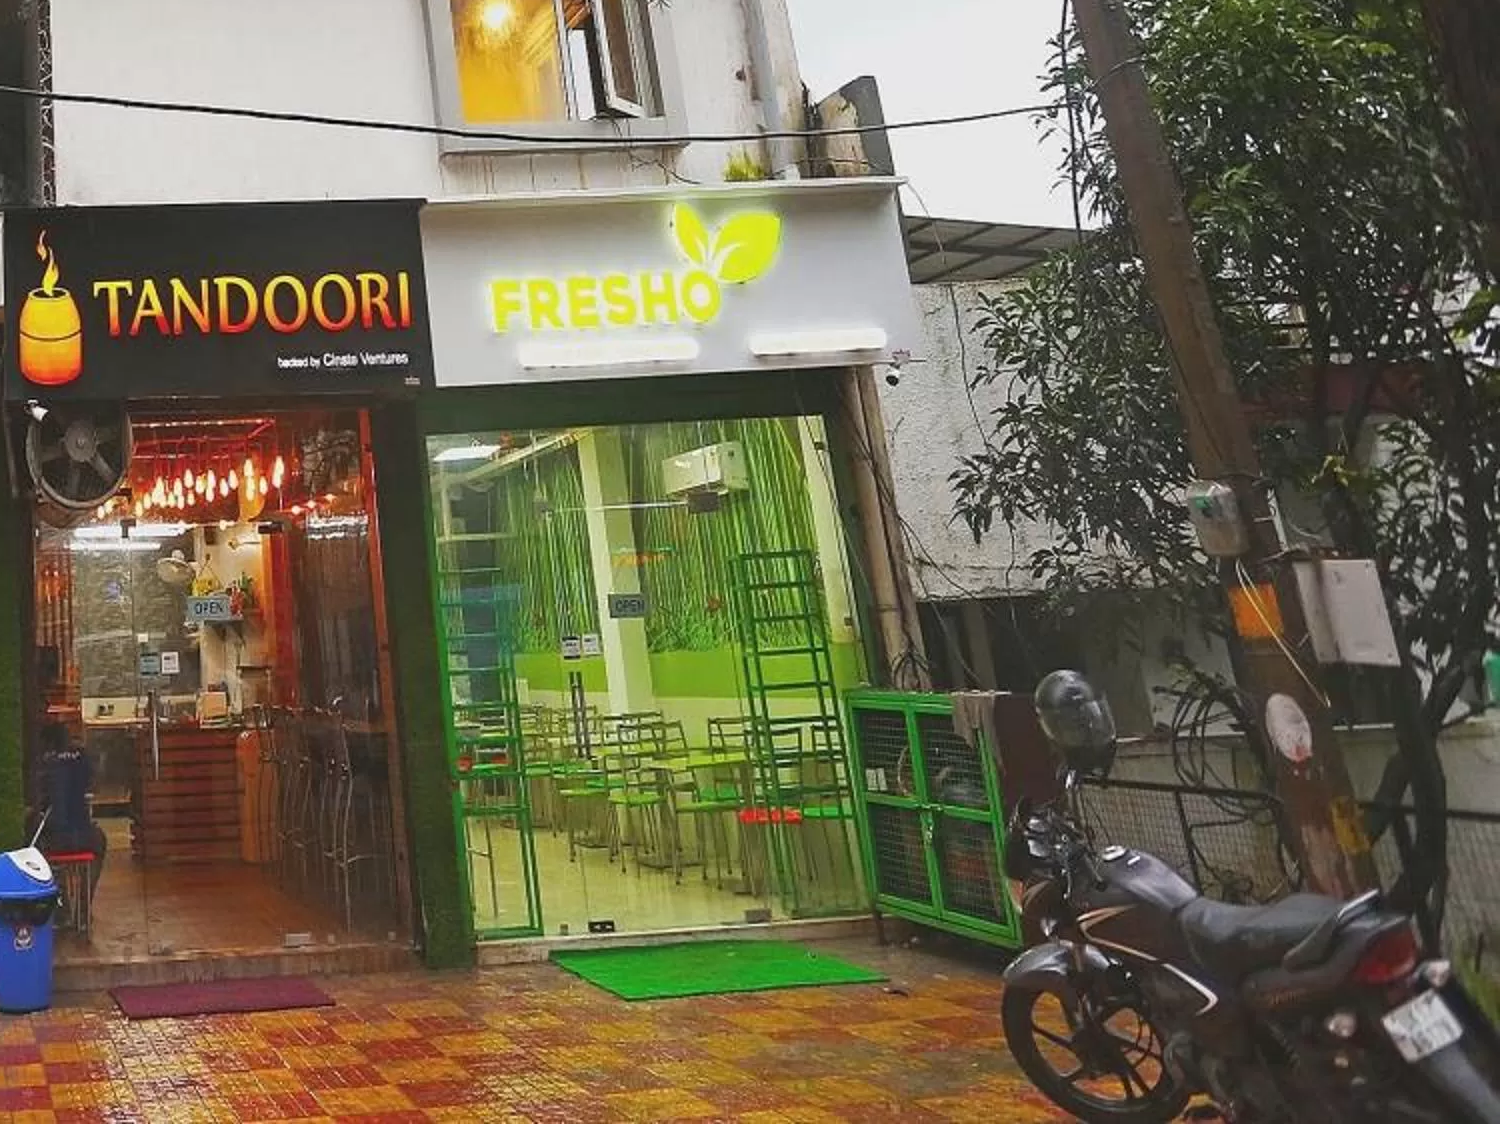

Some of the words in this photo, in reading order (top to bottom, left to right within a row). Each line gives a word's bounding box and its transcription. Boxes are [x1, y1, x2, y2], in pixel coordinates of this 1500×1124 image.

[93, 272, 412, 336] TANDOORI
[491, 270, 721, 333] FRESHO
[310, 356, 320, 369] by
[360, 351, 408, 365] Ventures
[194, 601, 223, 615] OPEN
[615, 599, 645, 613] OPEN
